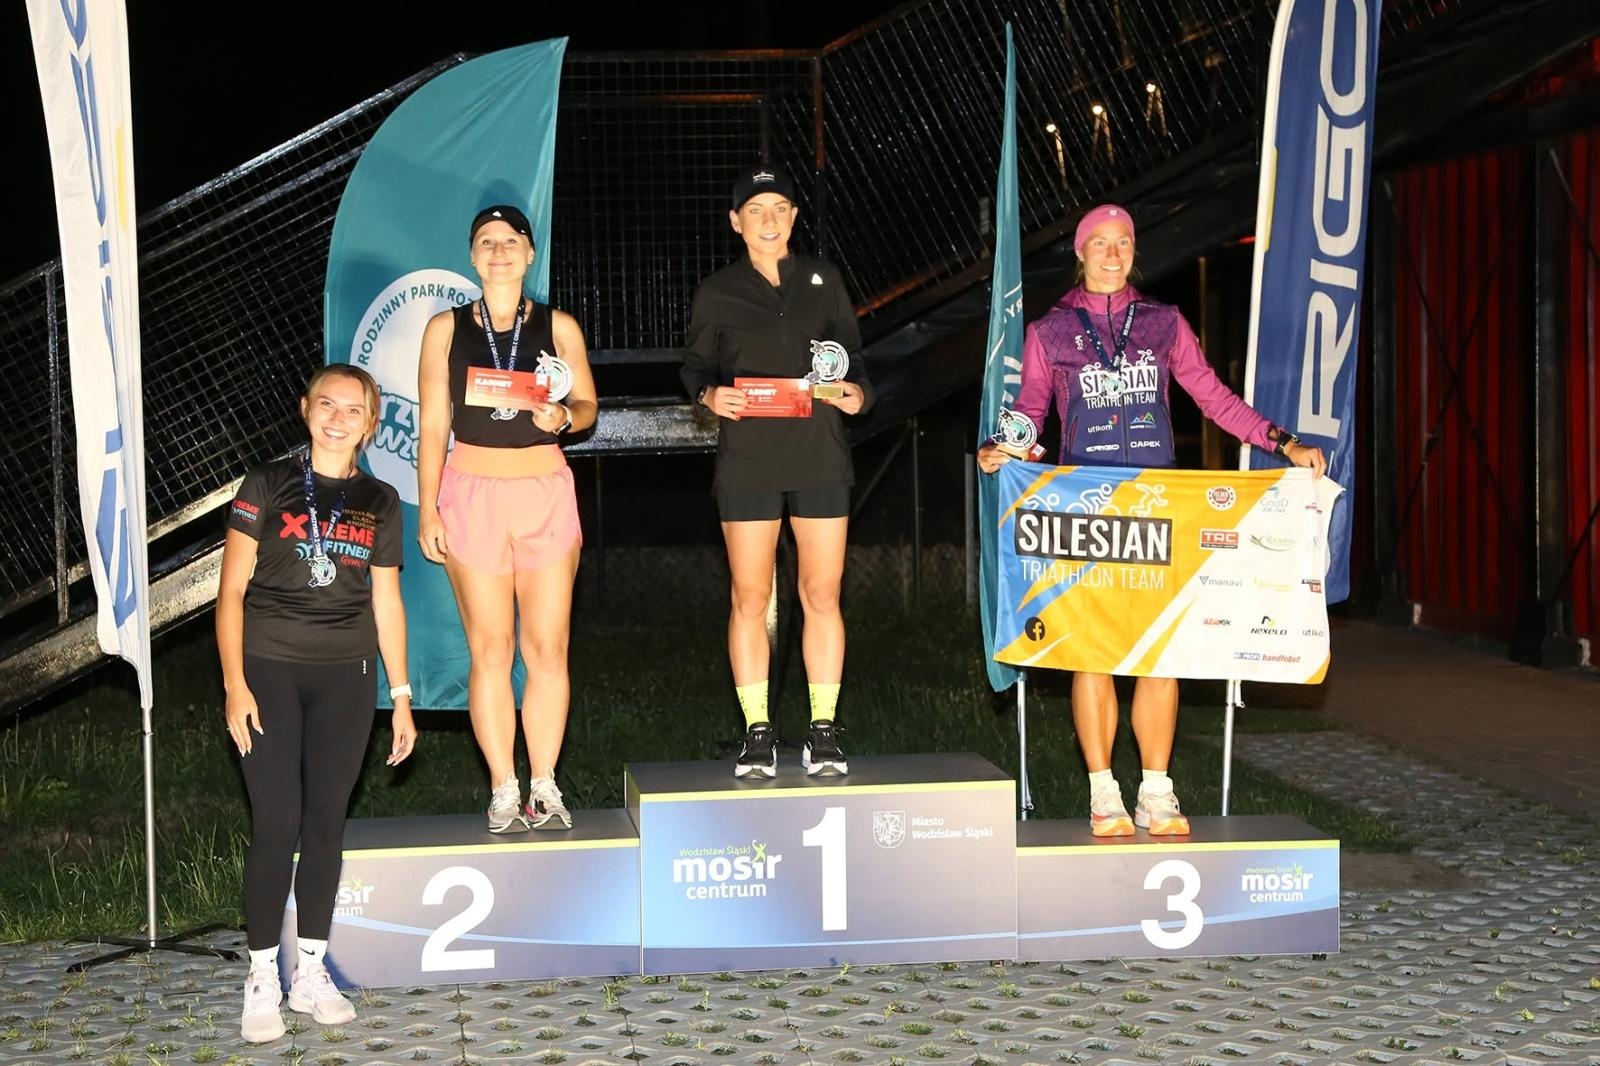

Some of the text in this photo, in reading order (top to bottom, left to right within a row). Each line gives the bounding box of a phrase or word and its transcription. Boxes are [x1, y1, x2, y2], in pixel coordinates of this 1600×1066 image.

[1297, 0, 1368, 440] RIGO
[357, 291, 407, 366] RODZINNY
[411, 283, 445, 300] PARK
[1082, 368, 1157, 395] SISIAN
[1134, 392, 1157, 405] TEAM
[1018, 513, 1169, 562] SILESIAN
[325, 540, 371, 560] FITNESS
[1020, 559, 1165, 591] TRIATHLON TEAM
[1208, 579, 1242, 587] manavi
[911, 816, 945, 826] Miasto
[911, 825, 993, 840] Wodzisław Śląski
[679, 845, 751, 858] Wodzisław Śląski
[672, 853, 783, 884] mosir
[802, 806, 848, 931] 1
[686, 882, 768, 900] centrum
[1242, 871, 1313, 891] mosir
[335, 884, 375, 905] sir
[1140, 859, 1205, 950] 3
[1249, 891, 1304, 903] centrum
[421, 865, 496, 972] 2
